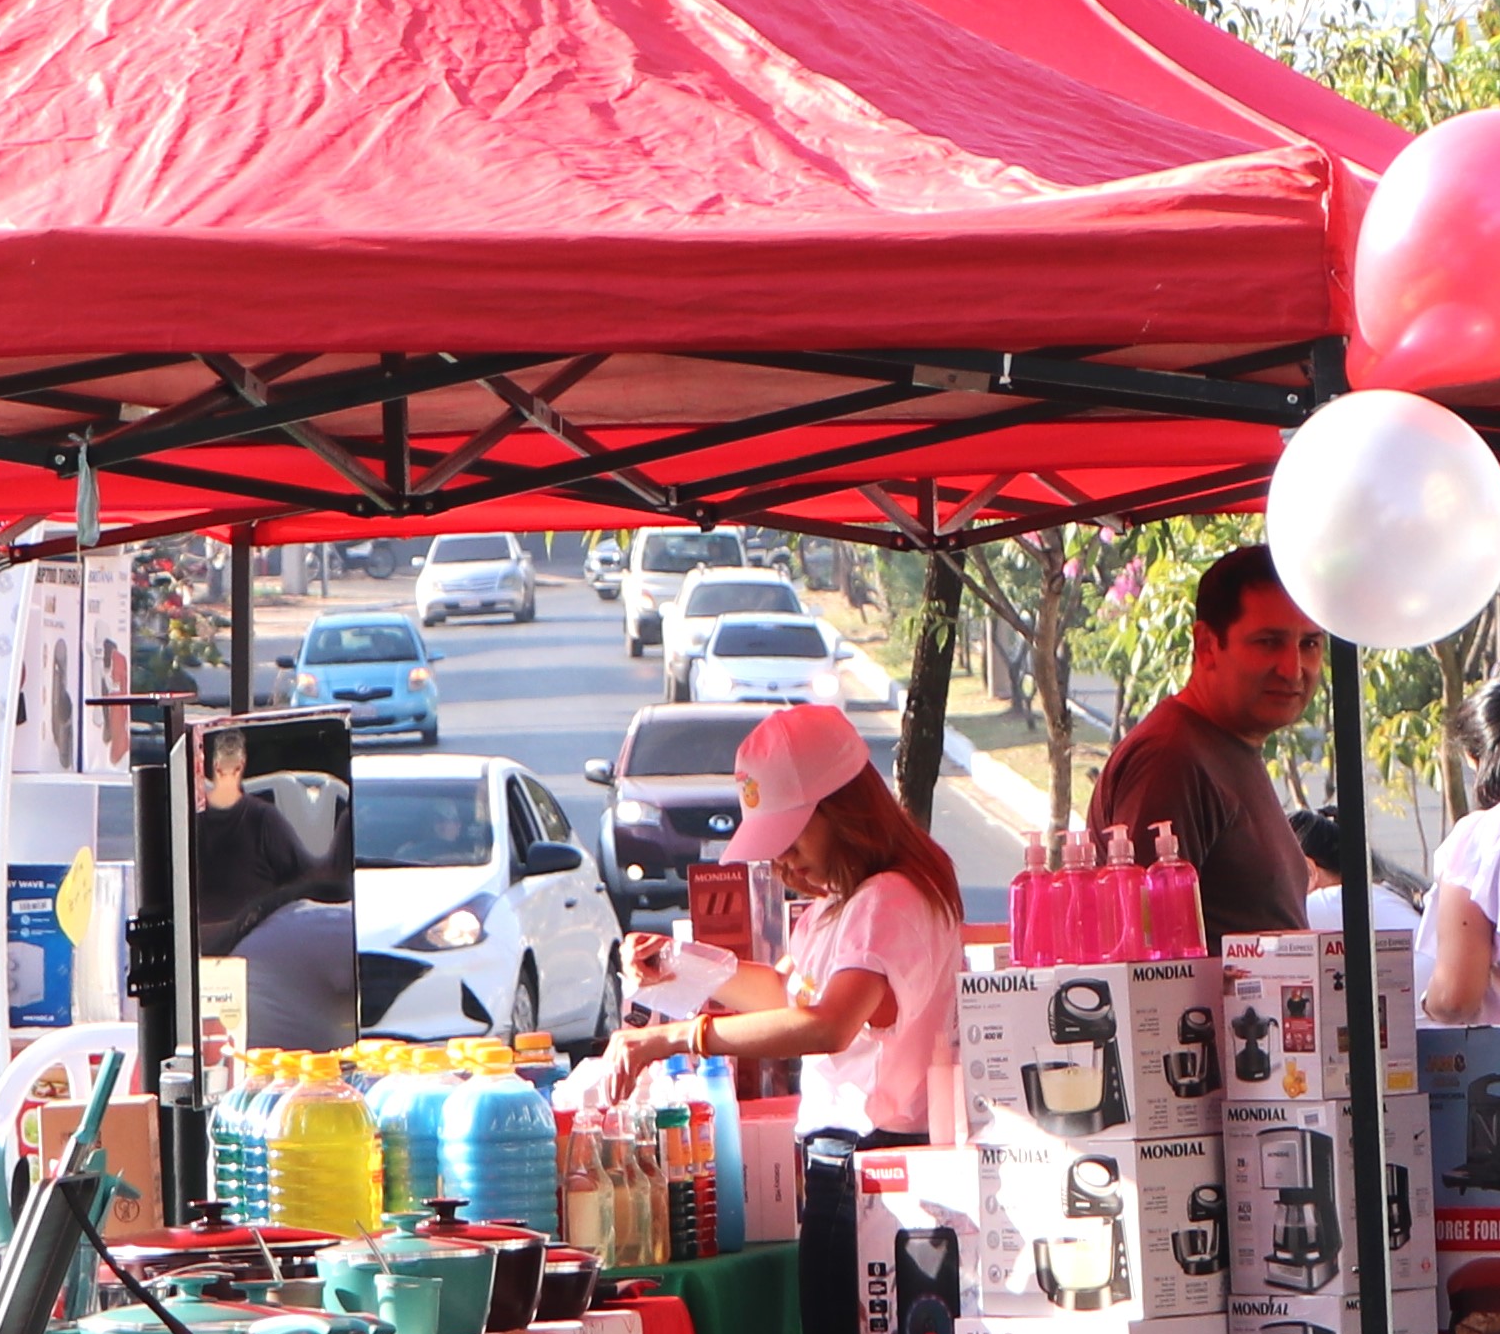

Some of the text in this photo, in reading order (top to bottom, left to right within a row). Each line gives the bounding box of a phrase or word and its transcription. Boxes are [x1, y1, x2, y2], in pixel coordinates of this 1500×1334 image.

[694, 871, 743, 883] MONDIAL
[1132, 965, 1195, 982] MONDIAL
[961, 975, 1038, 995] MONDIAL
[1227, 1108, 1287, 1121] MONDIAL
[982, 1149, 1051, 1165] MONDIAL
[1140, 1142, 1206, 1160] MONDIAL
[865, 1167, 905, 1180] aiwa
[1437, 1220, 1470, 1240] ORGE
[1231, 1302, 1290, 1316] MONDIAL
